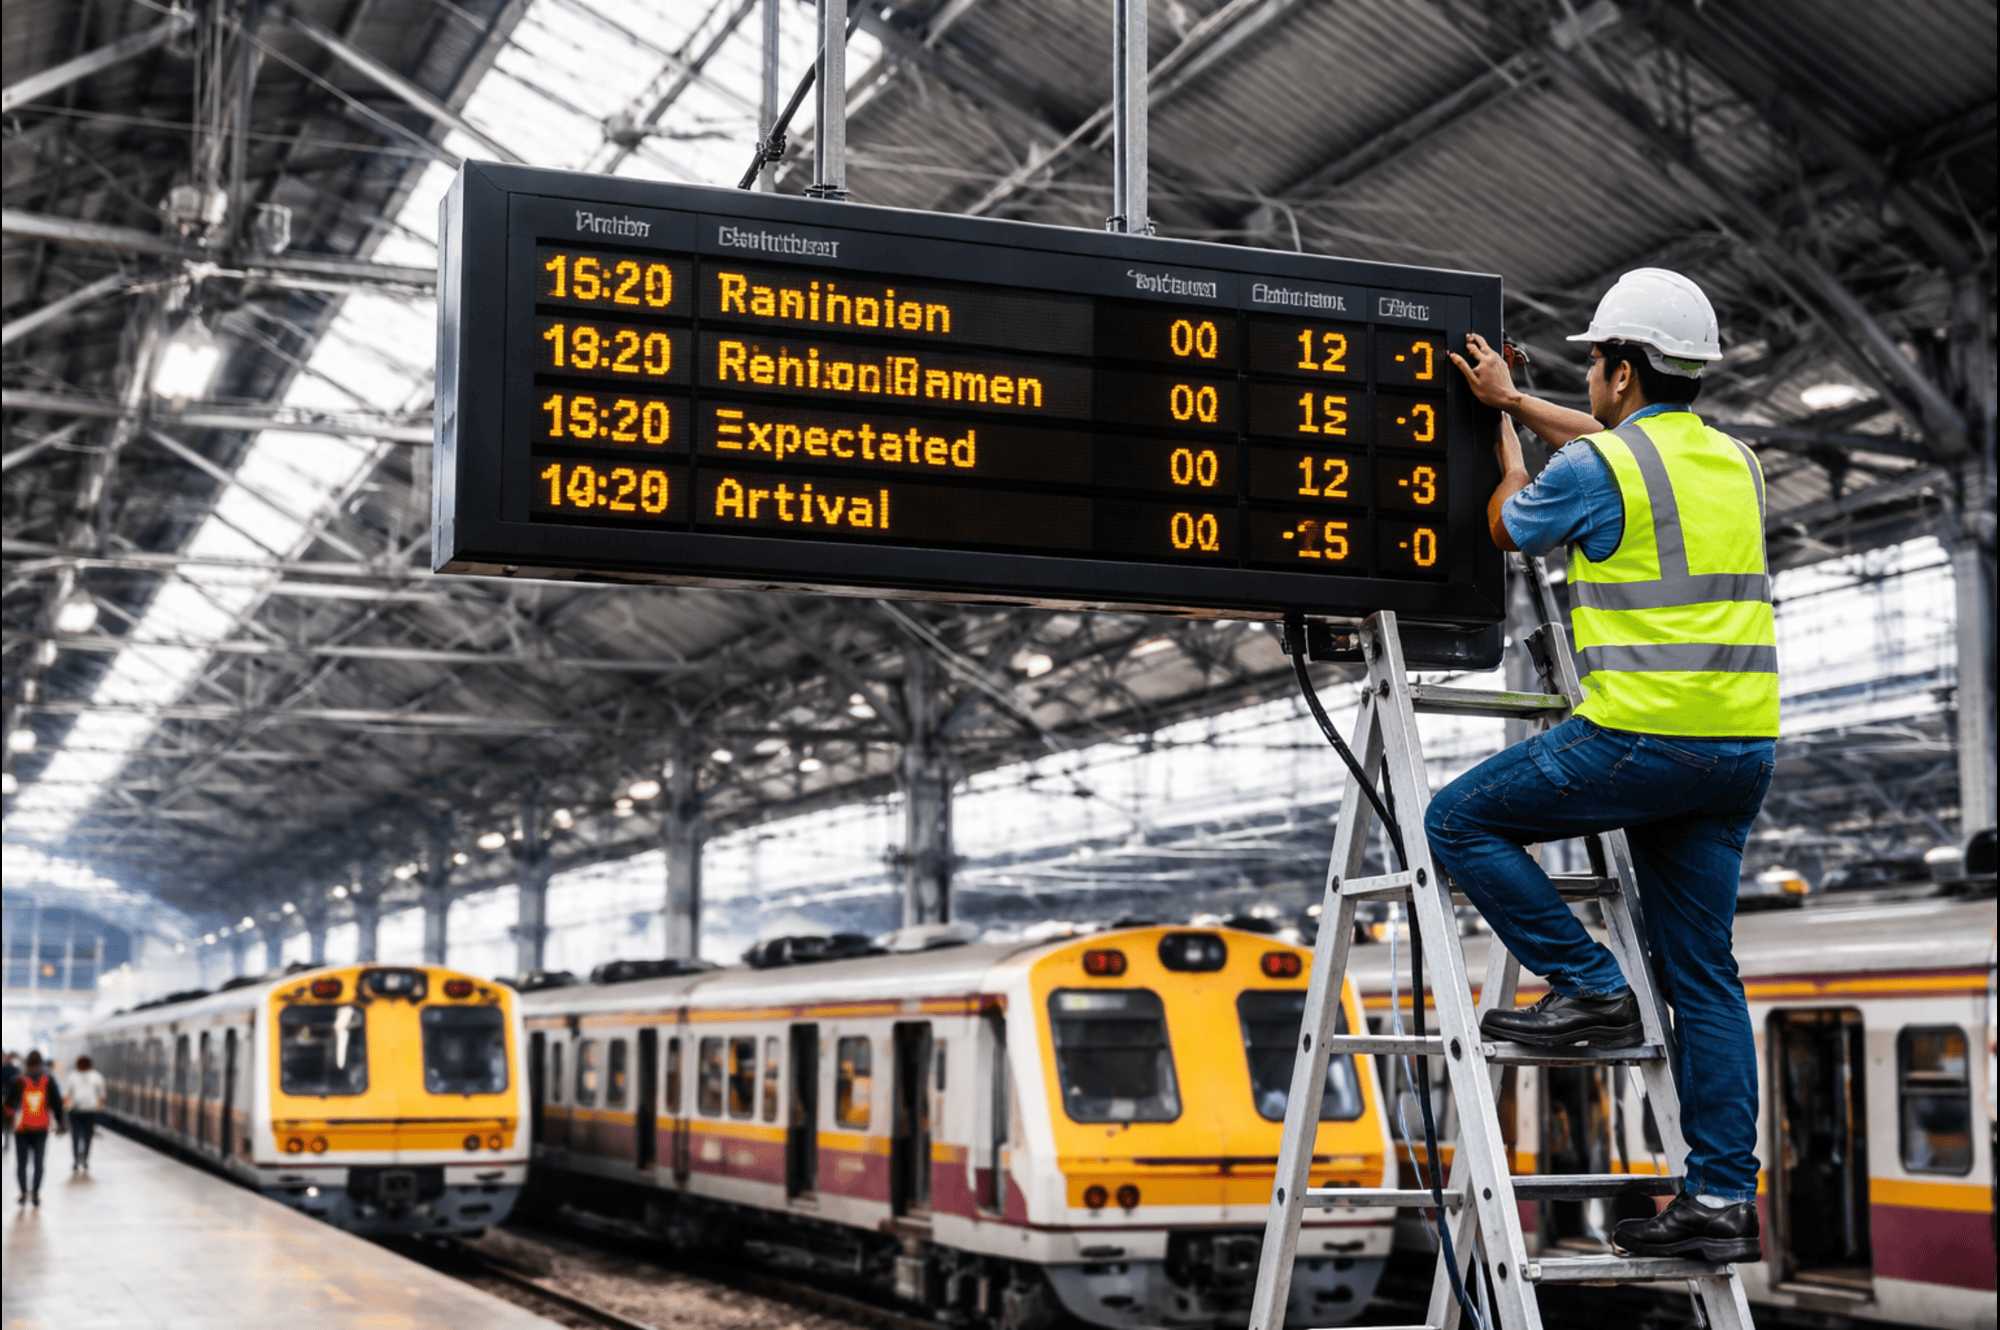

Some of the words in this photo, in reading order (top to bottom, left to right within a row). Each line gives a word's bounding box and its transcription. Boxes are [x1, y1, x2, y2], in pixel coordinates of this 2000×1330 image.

[1298, 330, 1347, 372] 12
[543, 395, 669, 444] 15:20
[716, 409, 976, 468] Expectated
[1298, 457, 1348, 497] 12
[716, 478, 889, 529] Artival
